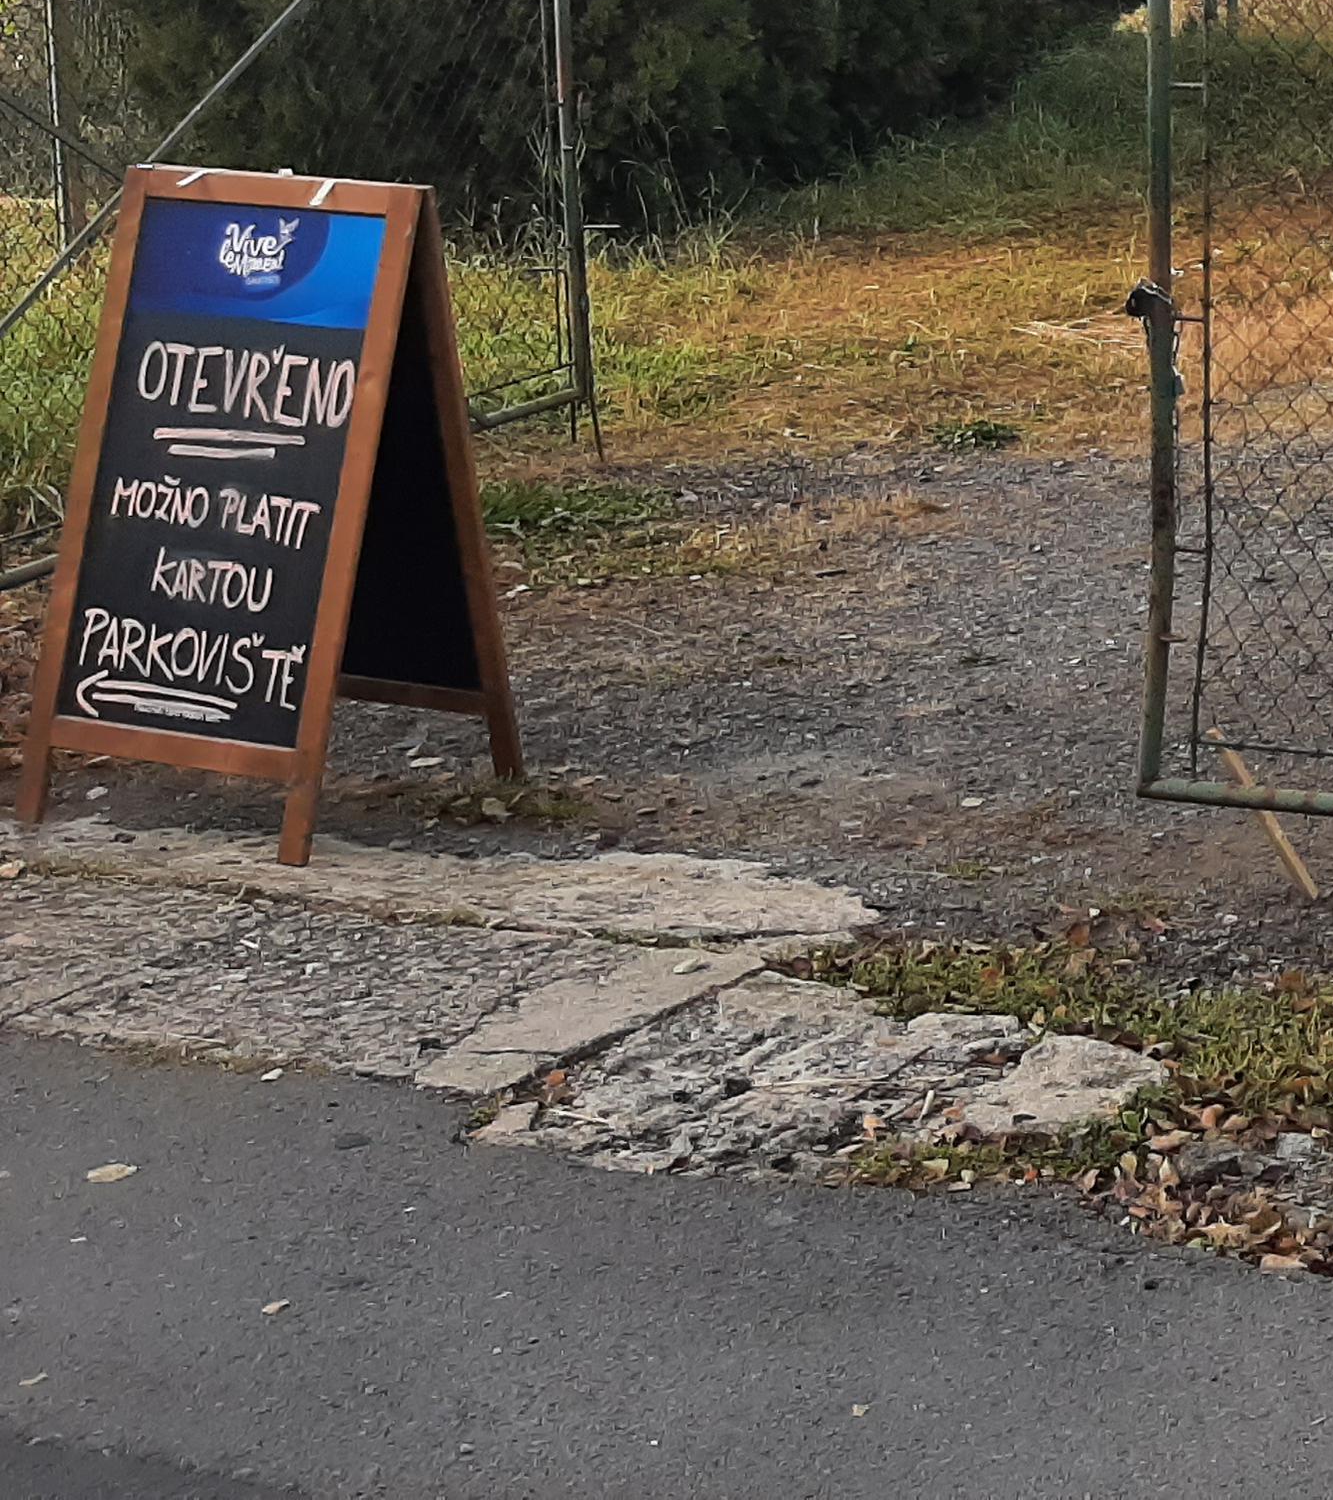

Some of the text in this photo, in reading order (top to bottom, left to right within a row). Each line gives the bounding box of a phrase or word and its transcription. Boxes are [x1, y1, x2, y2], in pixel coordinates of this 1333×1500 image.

[225, 223, 292, 257] Vive
[137, 341, 356, 428] OTEVŘENO
[110, 474, 321, 550] MOŽNO PLATIT
[150, 547, 273, 612] KARTOU
